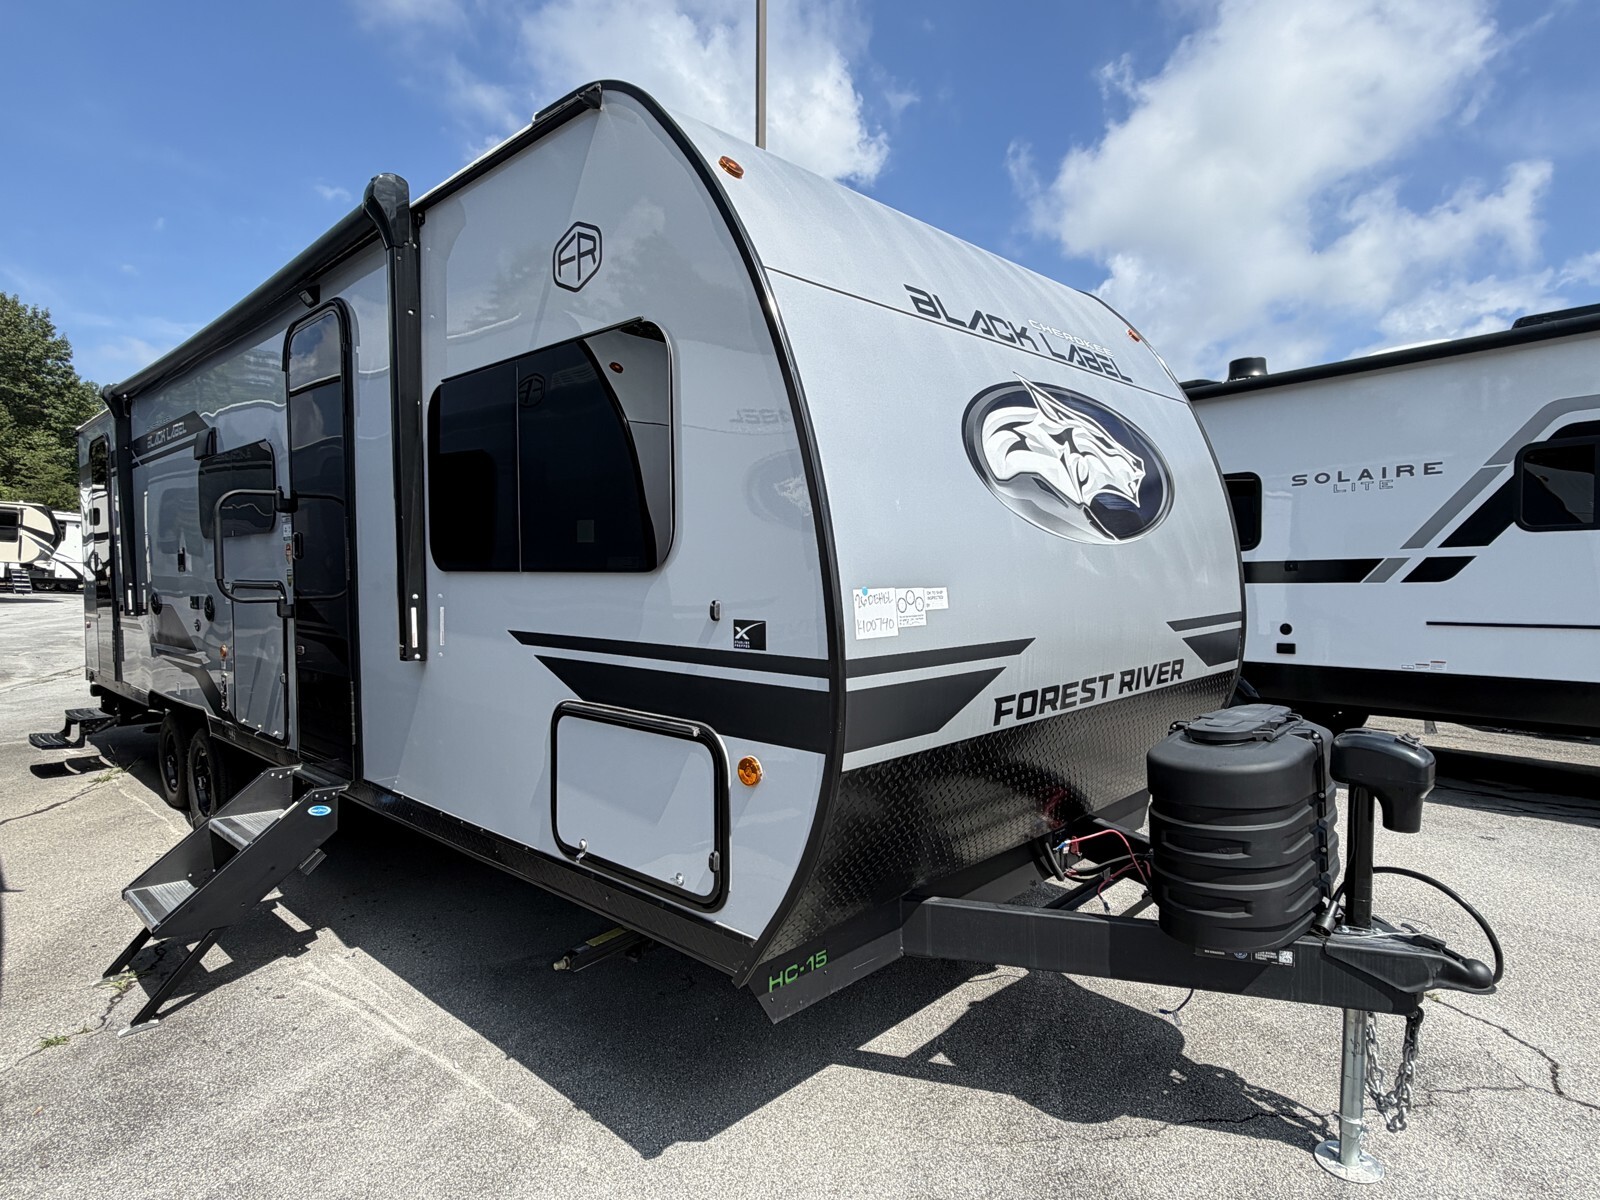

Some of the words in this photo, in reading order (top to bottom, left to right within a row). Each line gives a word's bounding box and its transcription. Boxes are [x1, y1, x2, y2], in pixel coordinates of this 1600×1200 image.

[903, 283, 1040, 352] BLACK
[1039, 332, 1133, 383] LABEL
[1028, 319, 1115, 358] CHEROKEE
[166, 421, 187, 441] LABEL
[1291, 461, 1443, 487] SOLAIRE
[1333, 479, 1394, 494] LITE
[993, 673, 1115, 727] FOREST
[1118, 658, 1185, 695] RIVER
[768, 949, 828, 993] HC-15
